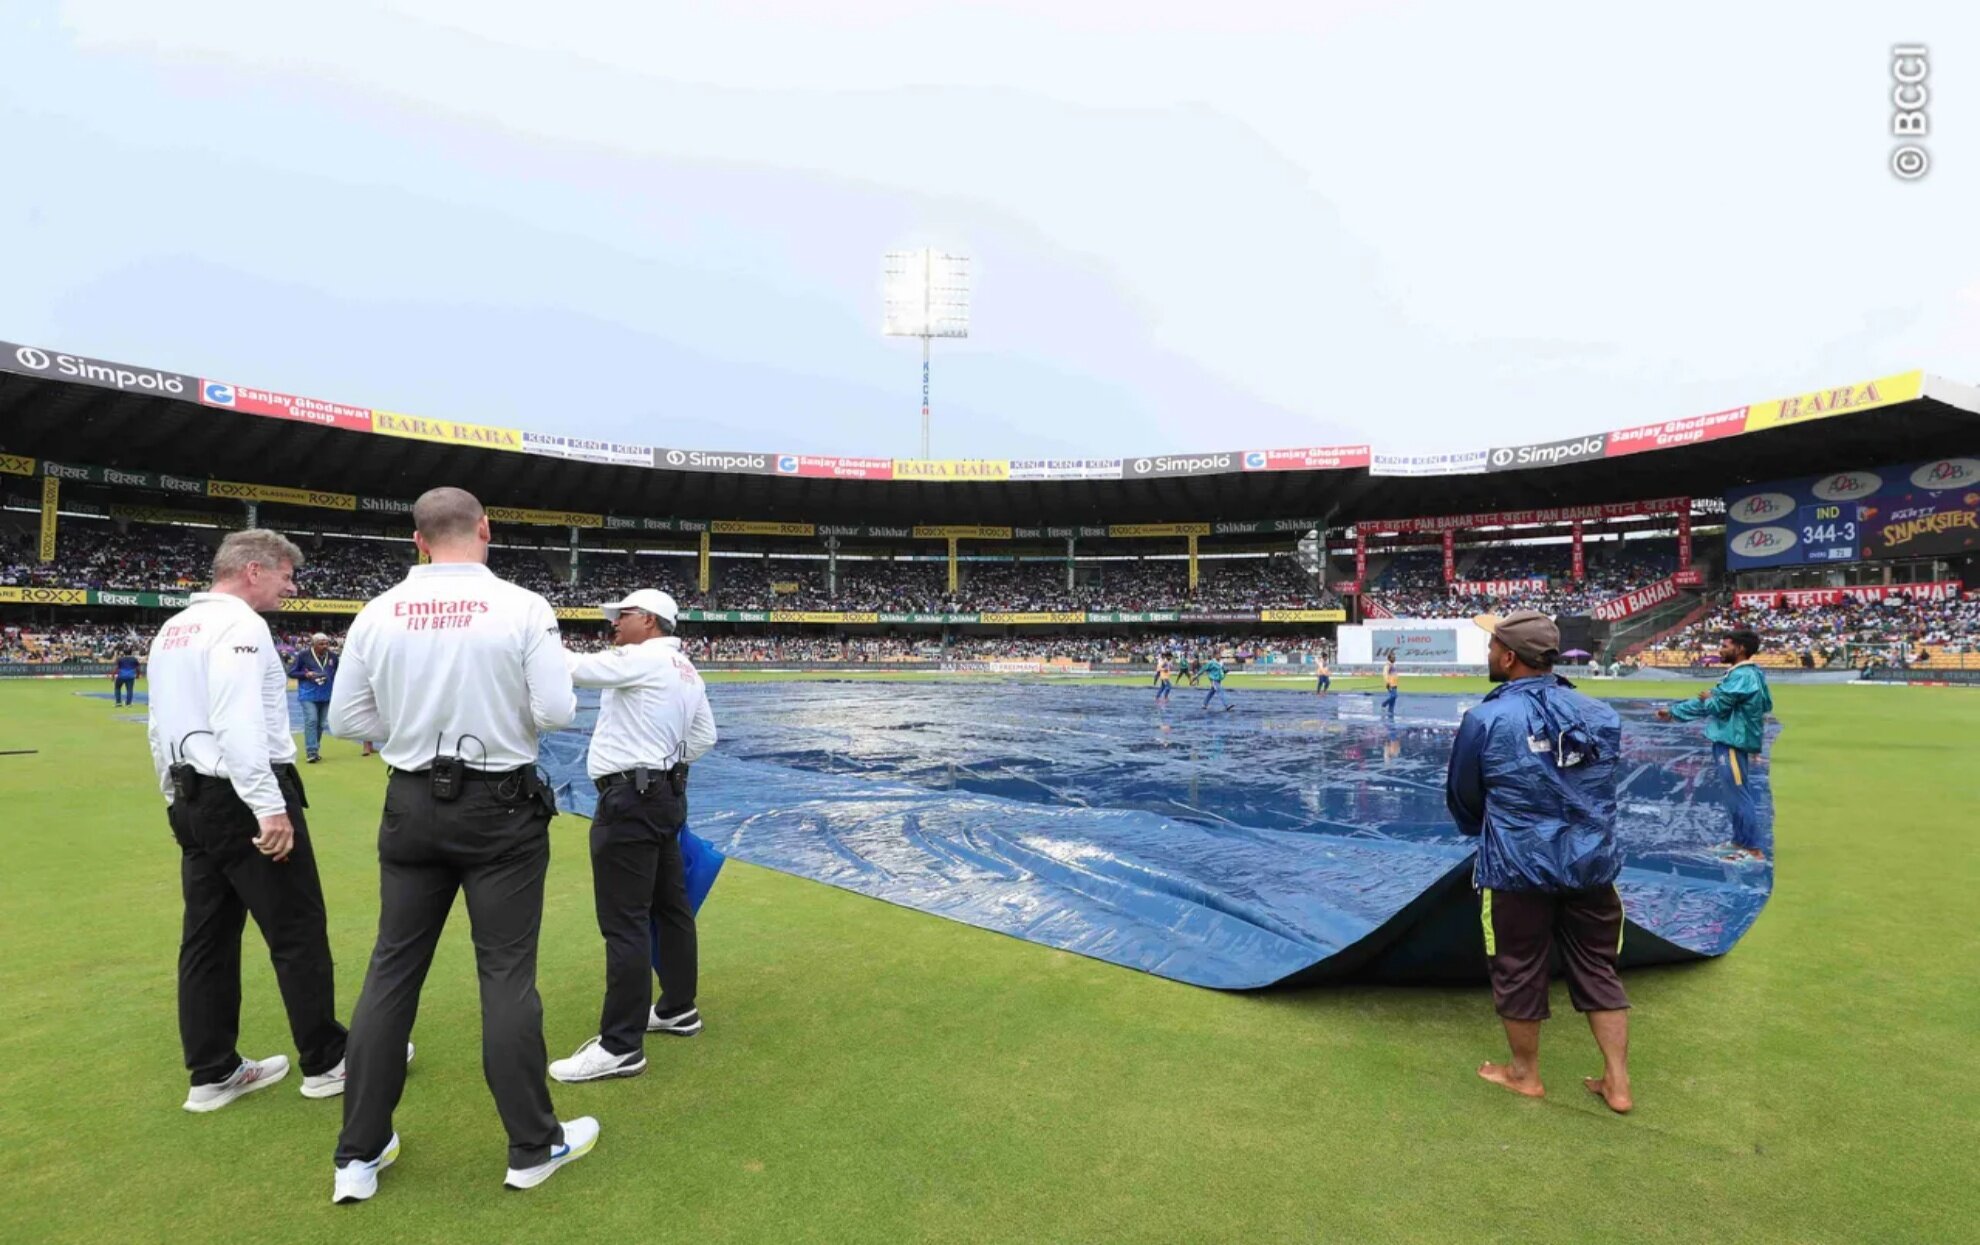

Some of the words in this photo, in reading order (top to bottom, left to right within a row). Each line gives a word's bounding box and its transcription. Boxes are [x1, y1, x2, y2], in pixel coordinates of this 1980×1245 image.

[57, 355, 183, 393] Simpolo
[238, 388, 292, 407] Sanjay
[295, 398, 370, 419] Ghodawat
[1775, 382, 1883, 420] BABA
[289, 407, 334, 423] Group
[379, 415, 443, 437] BABA
[454, 425, 515, 445] BABA
[1611, 426, 1662, 442] Sanjay
[1666, 409, 1746, 433] Ghodawat
[1657, 428, 1703, 445] Group
[1268, 449, 1306, 459] Sanjay
[1309, 447, 1367, 457] Ghodawat
[1517, 437, 1603, 463] Simpolo
[0, 458, 28, 472] XX
[690, 452, 765, 469] Simpolo
[801, 457, 836, 468] Sanjay
[839, 459, 890, 469] Ghodawat
[1155, 455, 1230, 471] Simpolo
[1305, 457, 1340, 466] Group
[44, 461, 89, 479] शिखर
[104, 469, 146, 486] शिखर
[161, 475, 200, 493] शिखर
[834, 467, 866, 476] Group
[898, 463, 946, 475] BABA
[954, 464, 1003, 475] BABA
[1928, 462, 1963, 482] A2B
[1828, 475, 1859, 493] A2B
[210, 483, 257, 498] ROXX
[309, 494, 352, 508] ROXX
[1745, 497, 1773, 515] A2B
[1816, 506, 1840, 520] IND
[488, 508, 524, 520] ROXX
[565, 514, 601, 525] ROXX
[1415, 518, 1435, 529] PAN
[1438, 515, 1473, 528] BAHAR
[1536, 509, 1558, 521] PAN
[1562, 506, 1601, 519] BAHAR
[713, 522, 745, 532] ROXX
[781, 524, 810, 534] ROXX
[819, 525, 859, 536] Shikhar
[869, 526, 908, 537] Shikhar
[915, 527, 945, 537] ROXX
[979, 528, 1009, 537] ROXX
[1111, 527, 1141, 536] ROXX
[1175, 525, 1208, 534] ROXX
[1215, 522, 1260, 533] Shikhar
[1275, 520, 1318, 530] Shikhar
[1803, 522, 1855, 544] 344-3
[1883, 511, 1979, 546] SNACKSTER
[1745, 531, 1774, 549] A2B
[21, 589, 80, 602] ROXX
[97, 592, 138, 606] शिखर
[1597, 600, 1626, 620] PAN
[1629, 580, 1676, 612] BAHAR
[279, 599, 309, 610] XX
[394, 599, 488, 617] Emirates
[407, 617, 429, 630] FLY
[431, 615, 472, 630] BETTER
[773, 612, 805, 621] ROXX
[842, 612, 873, 621] ROXX
[879, 614, 908, 622] Shikhar
[914, 614, 943, 622] Shikhar
[949, 615, 977, 623] Shikhar
[983, 614, 1014, 622] ROXX
[1051, 614, 1083, 622] ROXX
[1269, 612, 1301, 620] ROXX
